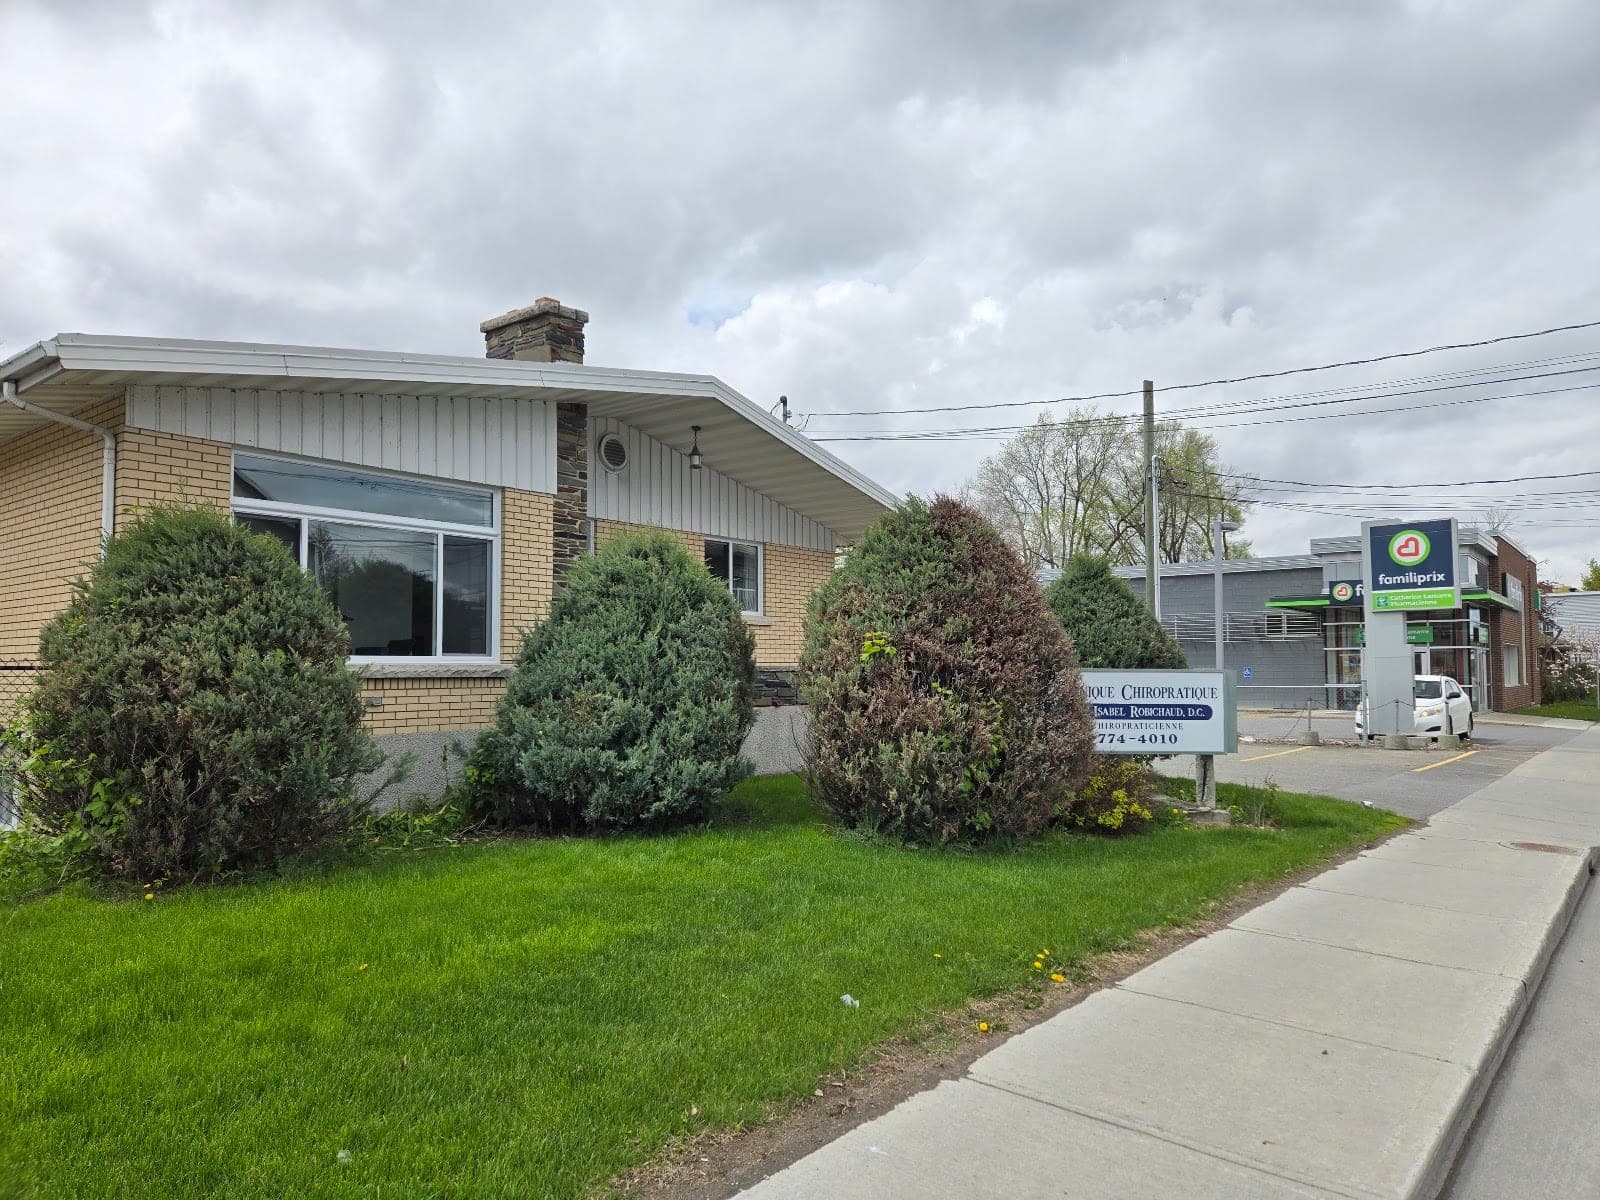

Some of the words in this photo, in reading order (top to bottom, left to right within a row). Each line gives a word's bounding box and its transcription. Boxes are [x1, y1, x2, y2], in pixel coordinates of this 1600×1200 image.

[1378, 571, 1446, 585] familiprix
[1121, 684, 1218, 700] CHIROPRATIQUE
[1094, 705, 1126, 717] ISABEL
[1130, 706, 1185, 718] ROBICHAUD,
[1188, 707, 1205, 717] D.C.
[1096, 722, 1184, 730] HIROPRATICIENNE
[1098, 733, 1178, 744] 774-4010
